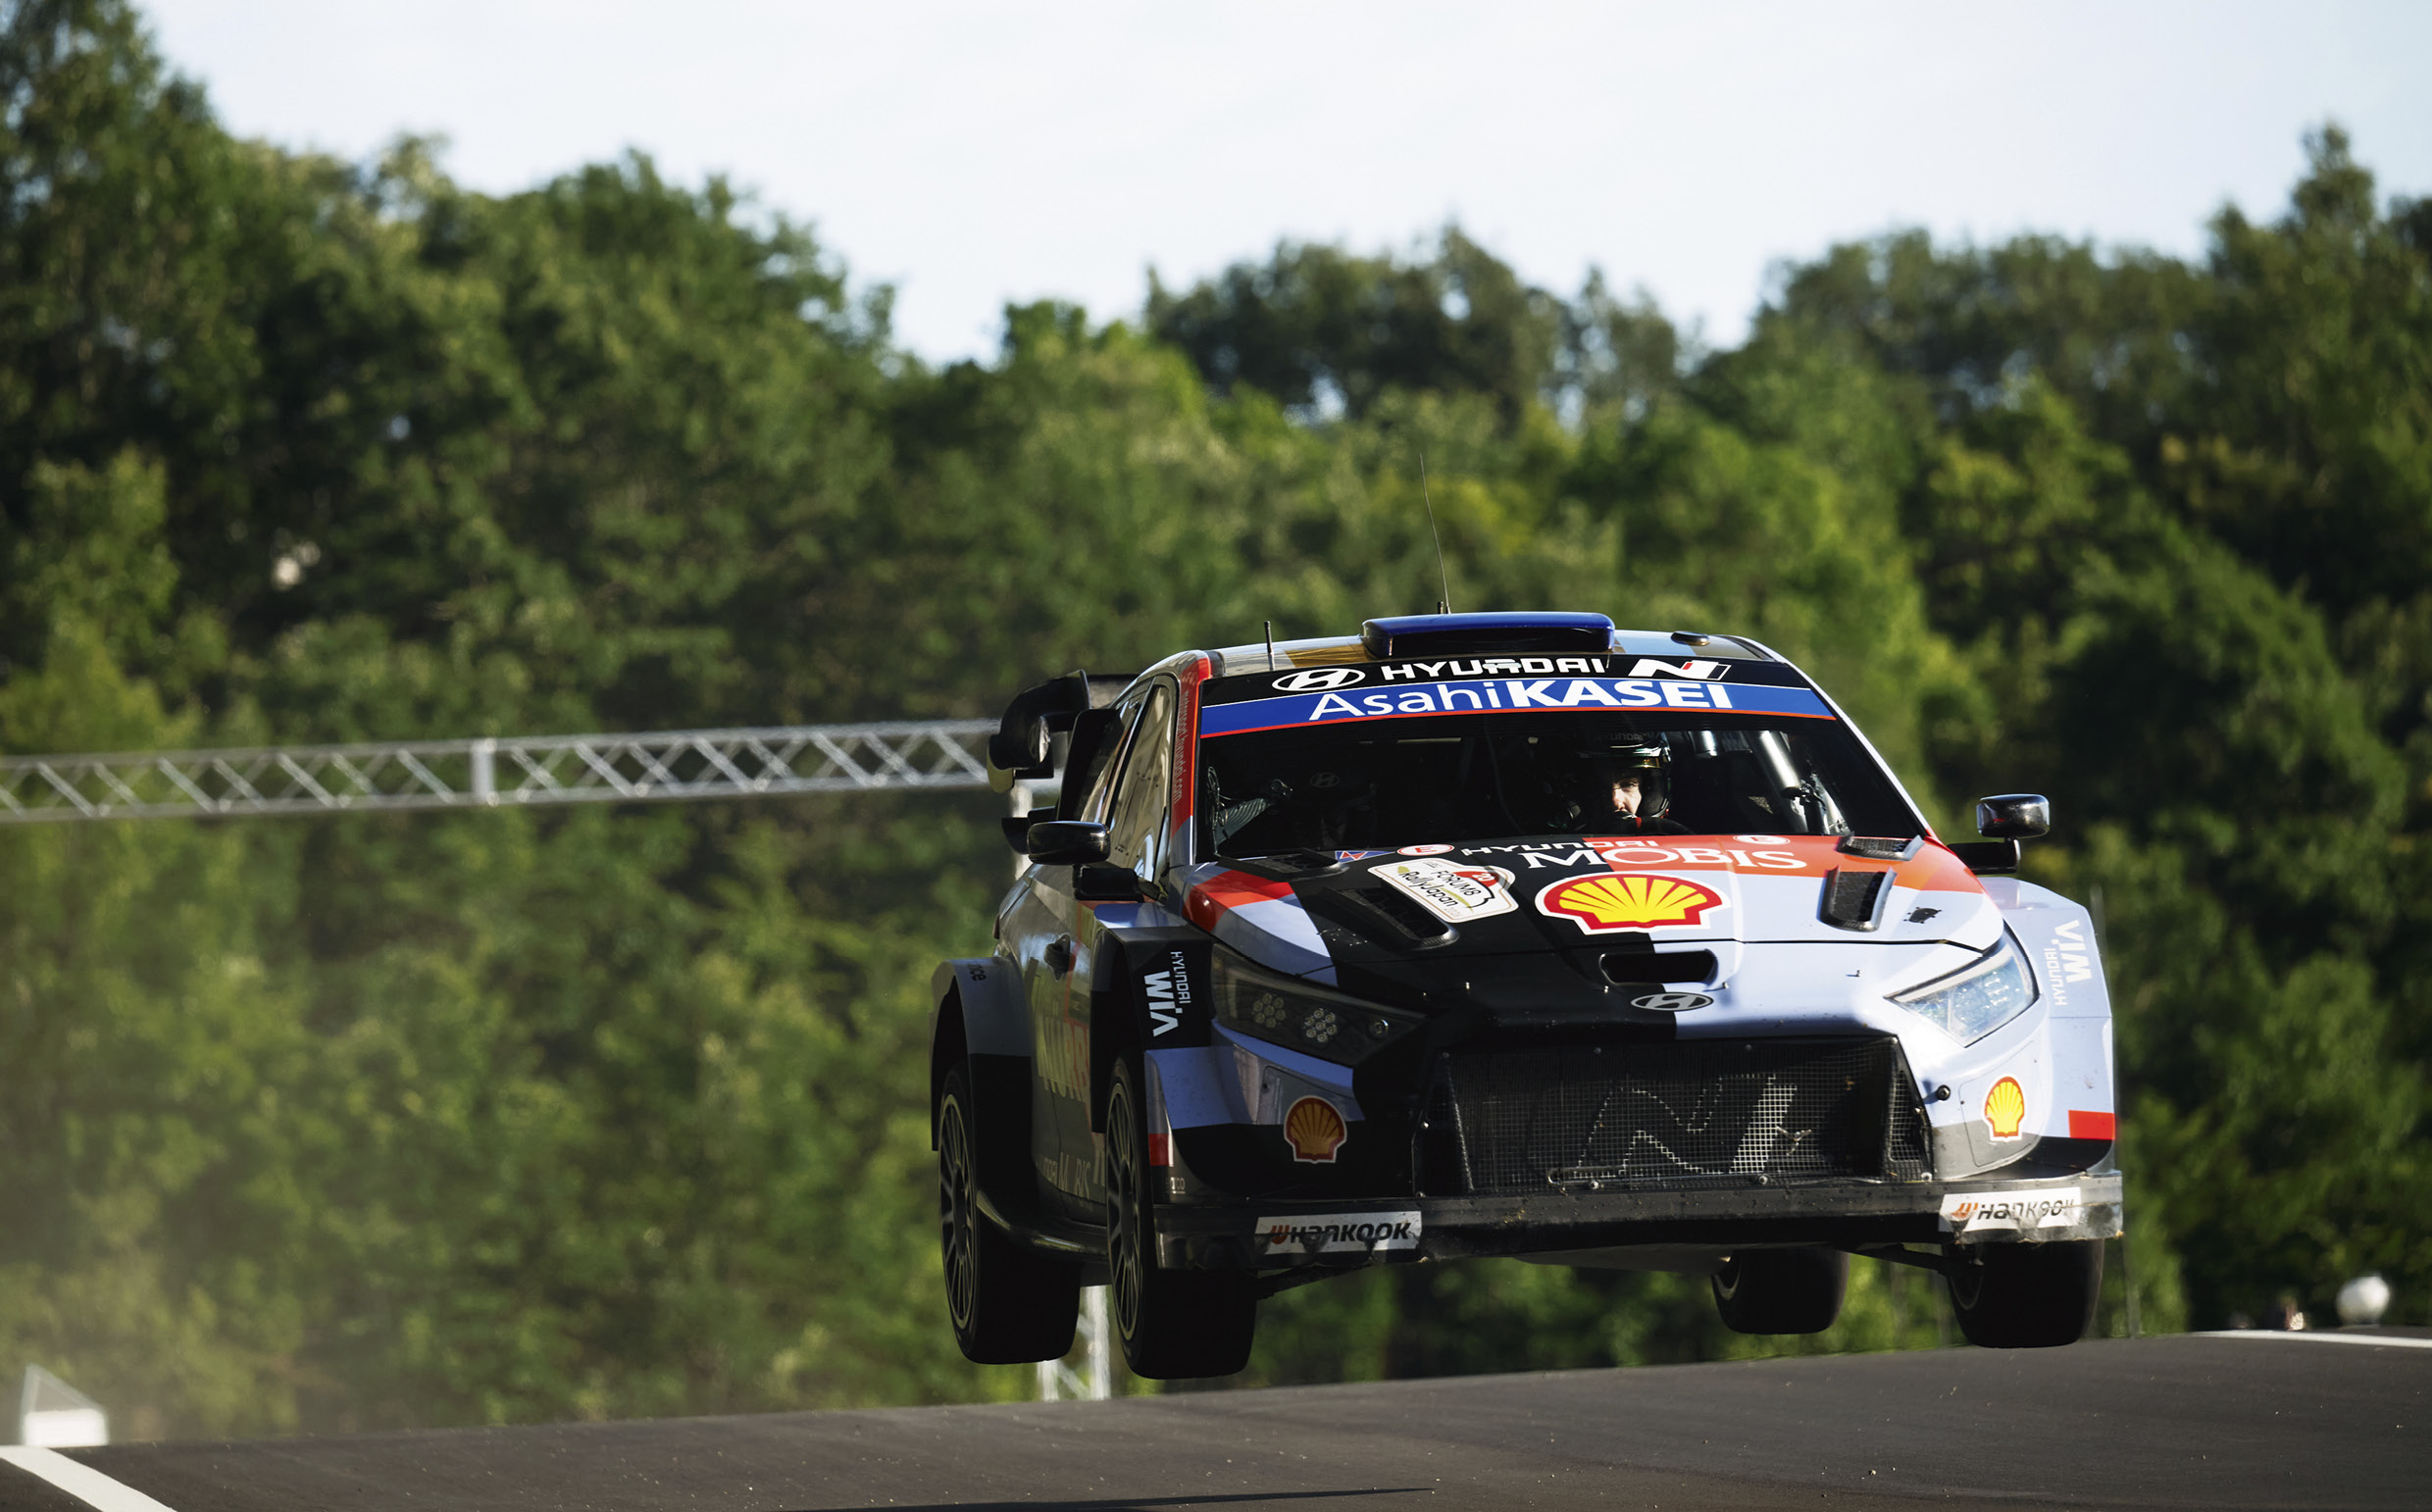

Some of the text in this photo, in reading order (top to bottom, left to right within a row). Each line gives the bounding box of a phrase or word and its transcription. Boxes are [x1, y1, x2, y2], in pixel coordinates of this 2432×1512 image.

[1380, 657, 1606, 681] HYUNDAI
[1460, 839, 1659, 856] HYUNDAI
[1517, 846, 1808, 870] MOBIS
[1431, 870, 1482, 896] FORUM8
[1170, 950, 1191, 1004] HYUNDAI
[2043, 947, 2068, 1006] HYUNDAI
